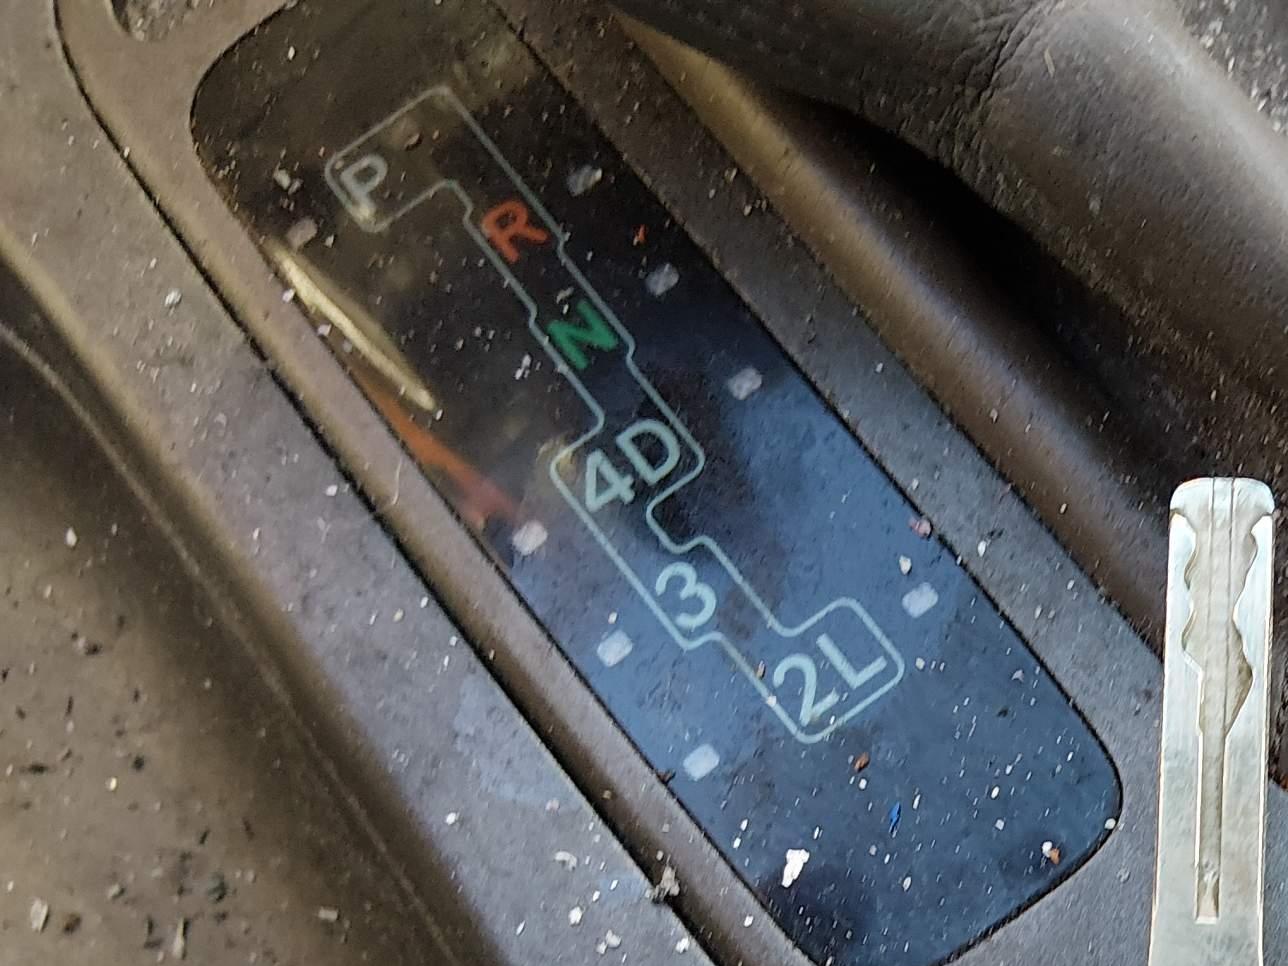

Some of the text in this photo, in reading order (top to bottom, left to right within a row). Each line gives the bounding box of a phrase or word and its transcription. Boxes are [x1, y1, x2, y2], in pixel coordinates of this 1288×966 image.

[340, 154, 387, 221] P
[480, 199, 550, 263] R
[545, 300, 618, 369] N
[655, 562, 717, 628] 3
